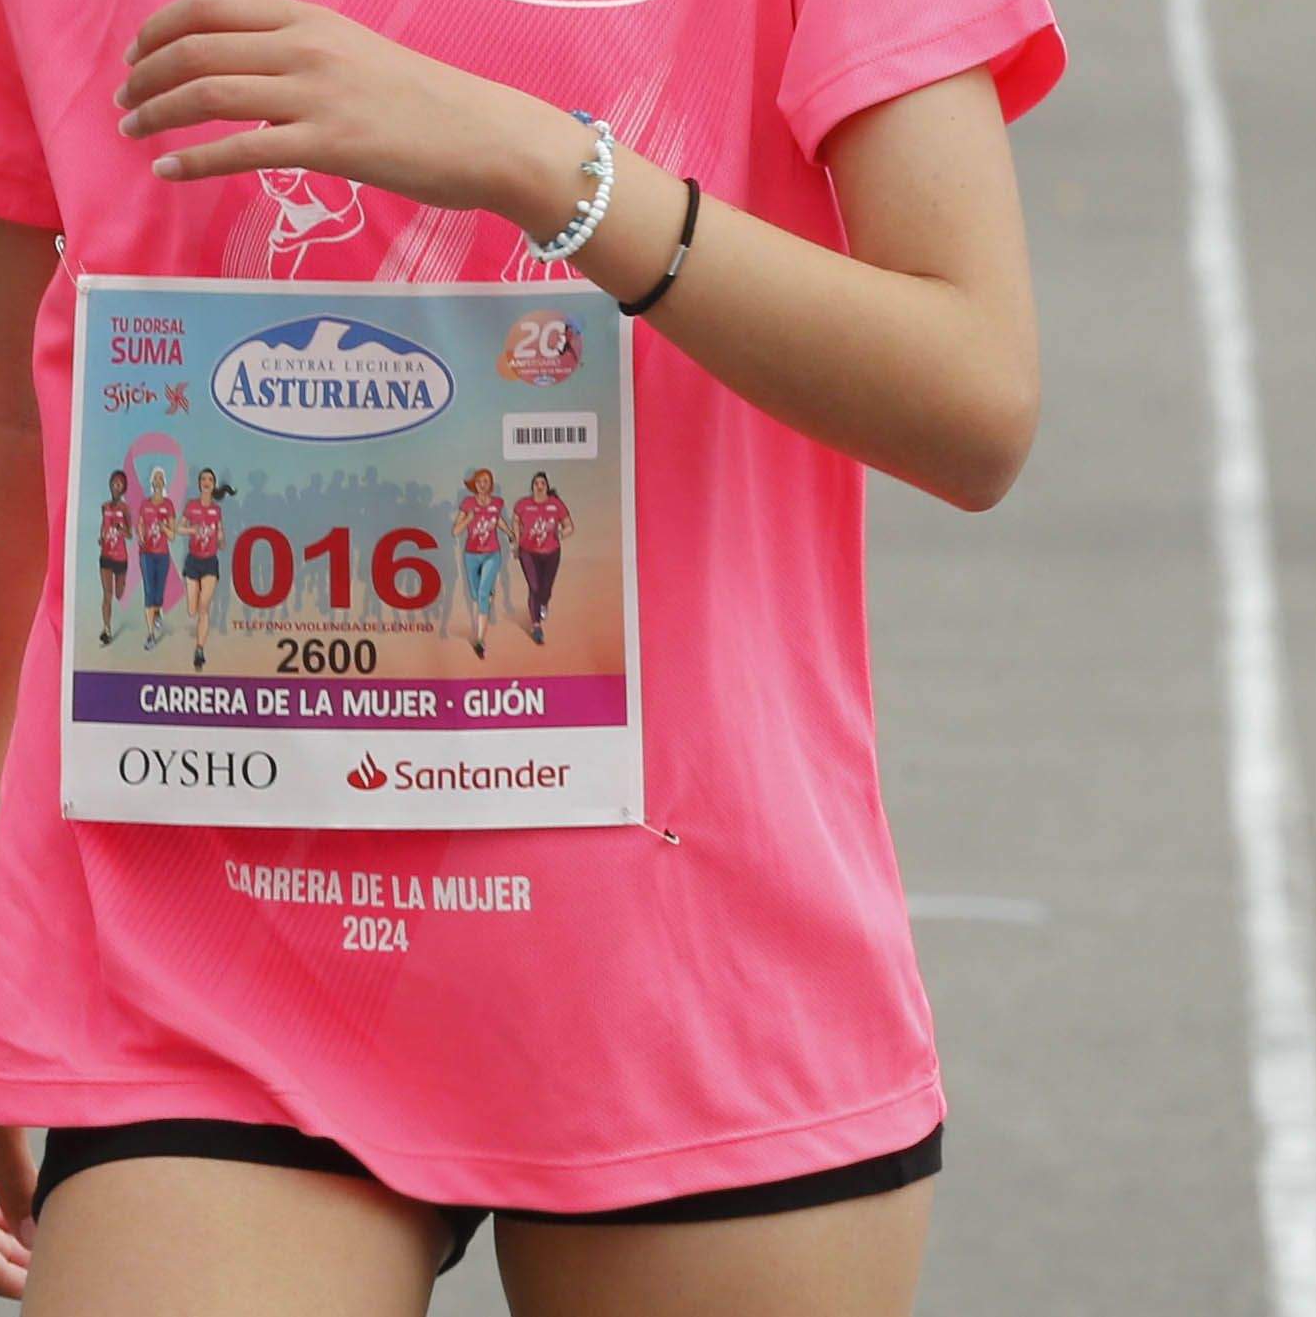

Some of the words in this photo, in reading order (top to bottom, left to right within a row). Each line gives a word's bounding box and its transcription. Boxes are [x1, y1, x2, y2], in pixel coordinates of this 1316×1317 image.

[111, 316, 129, 333] TU
[133, 317, 186, 336] DORSAL
[111, 336, 183, 365] SUMA
[261, 357, 335, 372] CENTRAL
[344, 358, 426, 373] LECHERA
[226, 360, 434, 410] ASTURIANA
[231, 525, 442, 611] 016
[295, 621, 361, 633] VIOLENCIA
[363, 622, 379, 633] DE
[276, 638, 377, 674] 2600
[139, 684, 248, 715] CARRERA
[257, 689, 290, 717] DE
[300, 689, 333, 717] LA
[343, 689, 437, 718] MUJER
[464, 681, 545, 718] GIJÓN
[119, 747, 278, 789] OYSHO
[394, 760, 571, 791] Santander
[225, 860, 343, 905] CARRERA
[352, 871, 383, 908] DE
[392, 875, 425, 910] LA
[431, 876, 531, 912] MUJER
[342, 915, 409, 952] 2024
